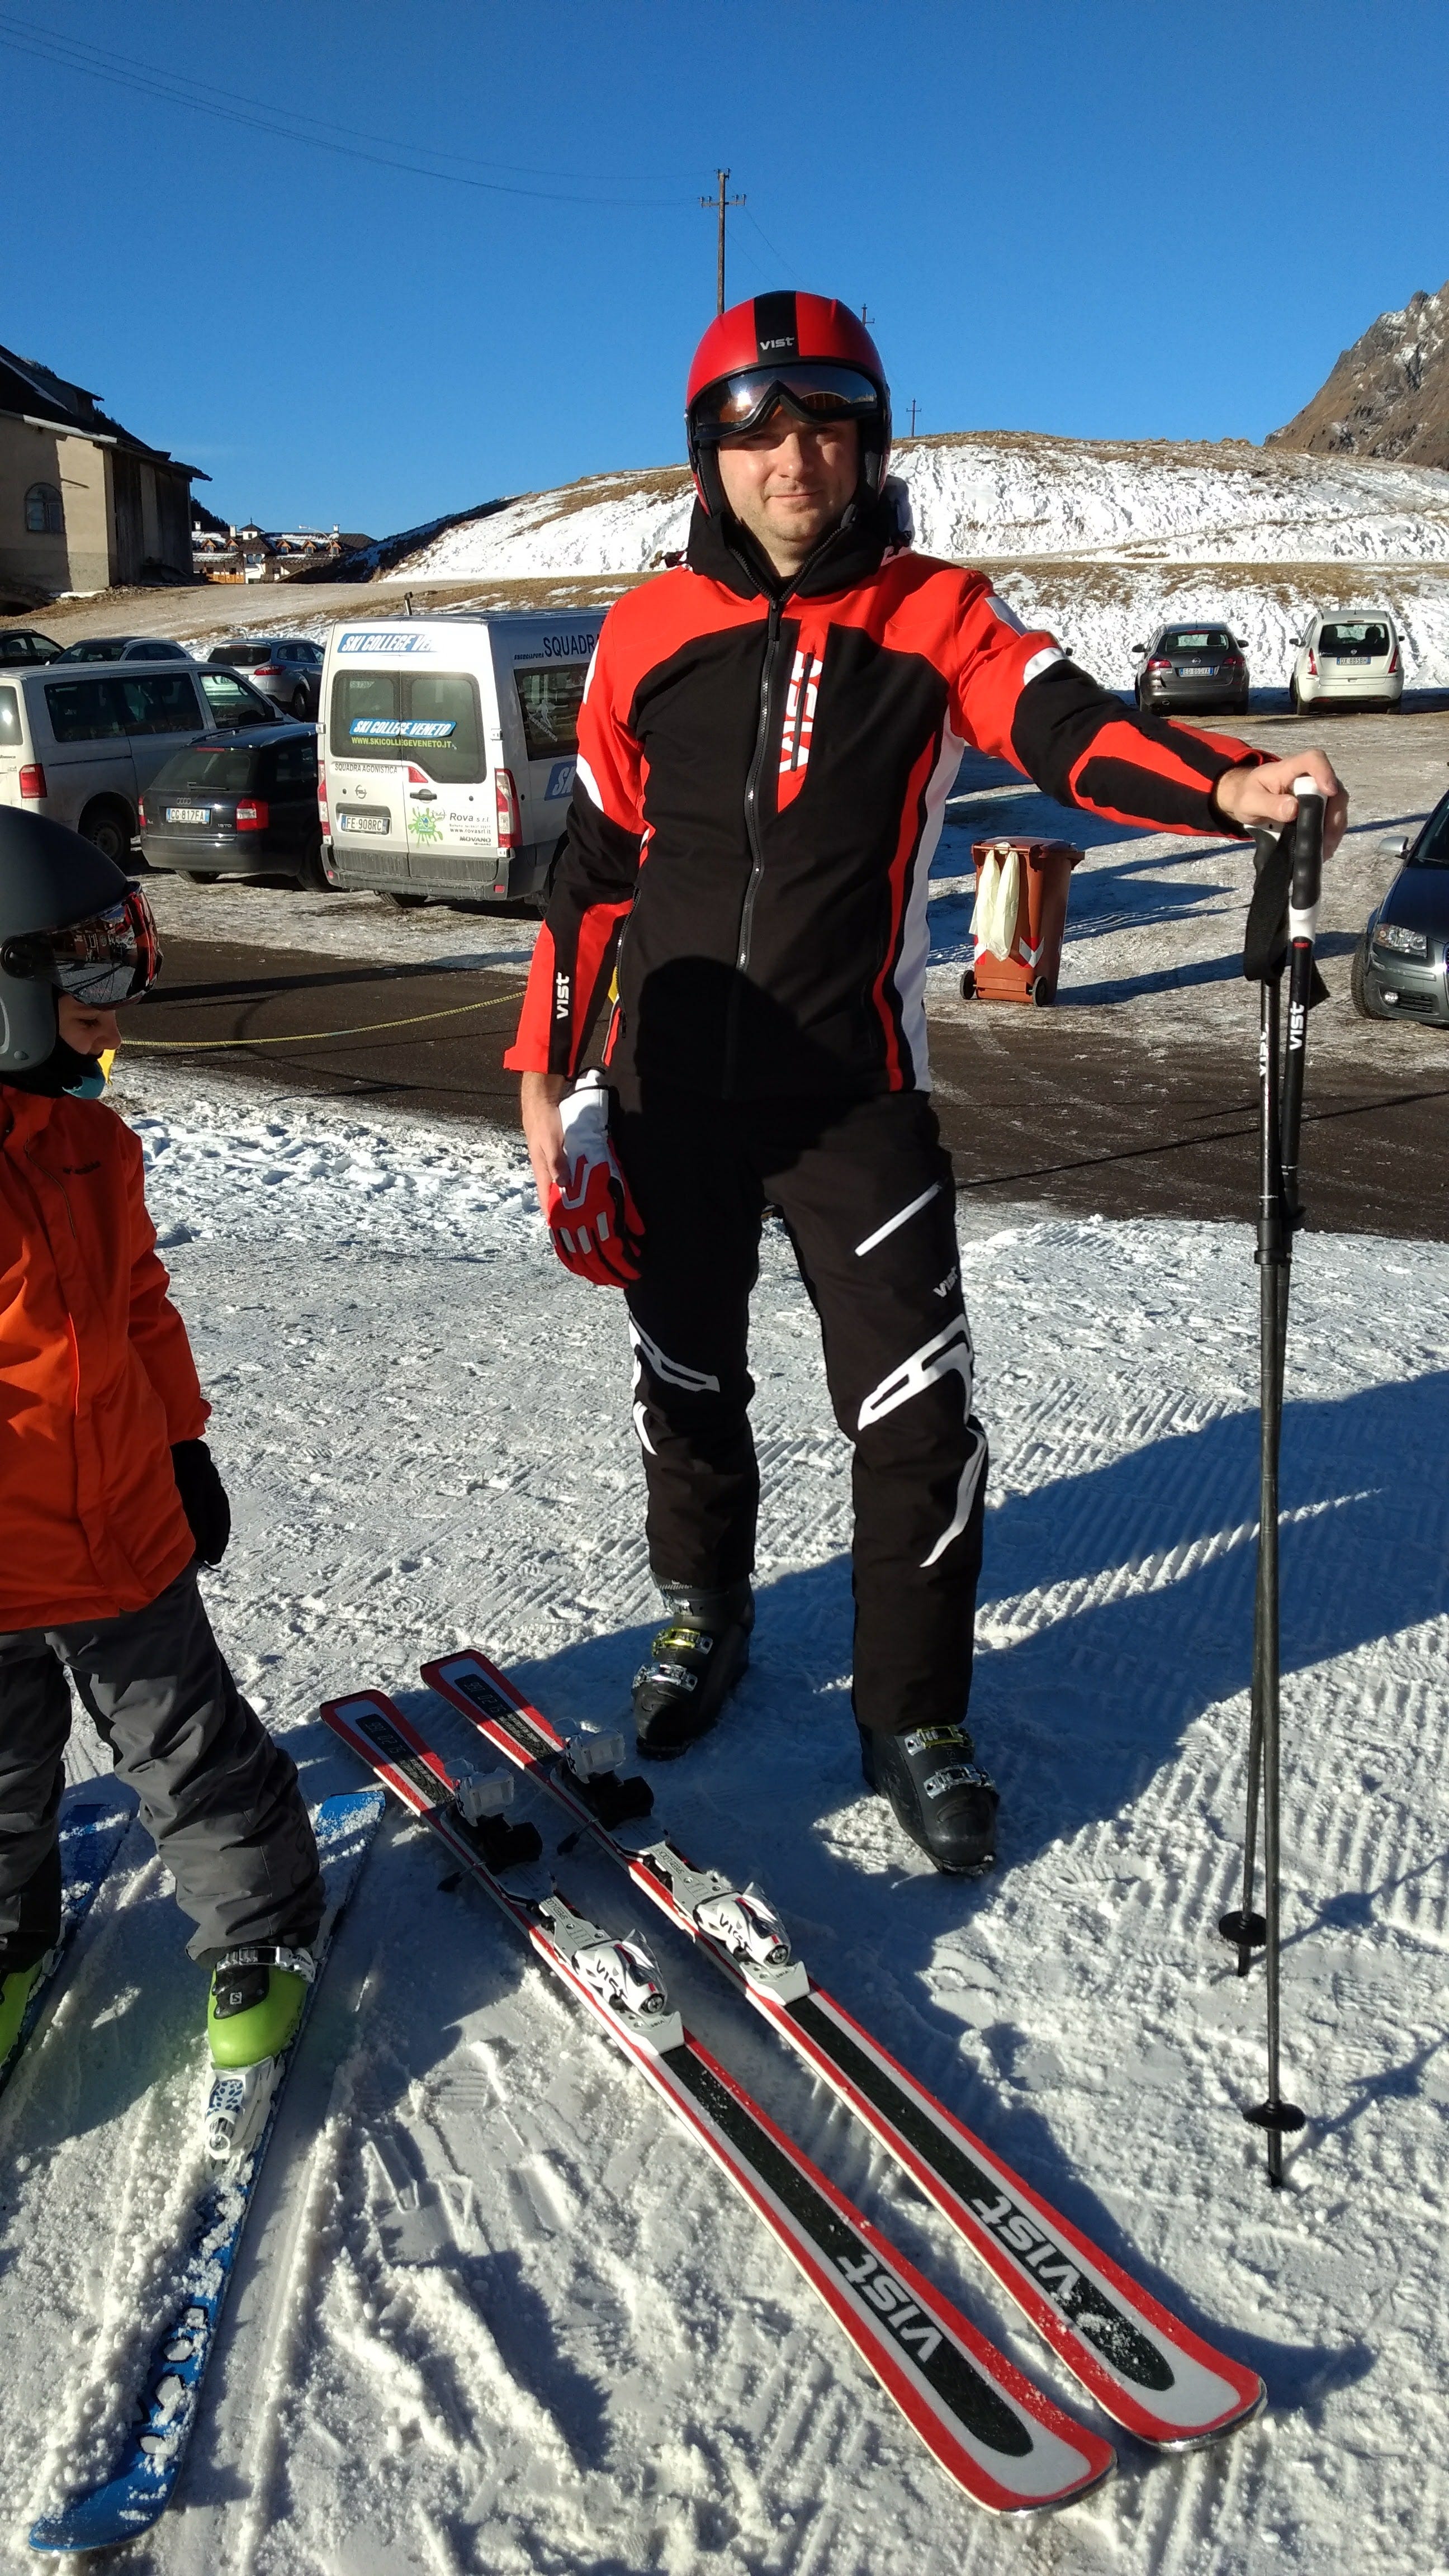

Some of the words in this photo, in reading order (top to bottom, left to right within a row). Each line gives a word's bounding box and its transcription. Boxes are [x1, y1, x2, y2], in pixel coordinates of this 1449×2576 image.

[342, 634, 366, 651] SKI
[361, 635, 416, 651] COLLEGE
[543, 633, 600, 657] SQUADR
[354, 721, 371, 733] SKI
[370, 721, 410, 735] COLLEGE
[409, 722, 452, 736] VENETO
[351, 737, 452, 748] WWW.SKICOLLEGEVENETO.IT
[335, 763, 361, 771] SQUADRA
[362, 765, 397, 774] AGONISTICA
[346, 817, 356, 828] FE
[358, 818, 382, 831] 908RC
[449, 812, 473, 822] Rova
